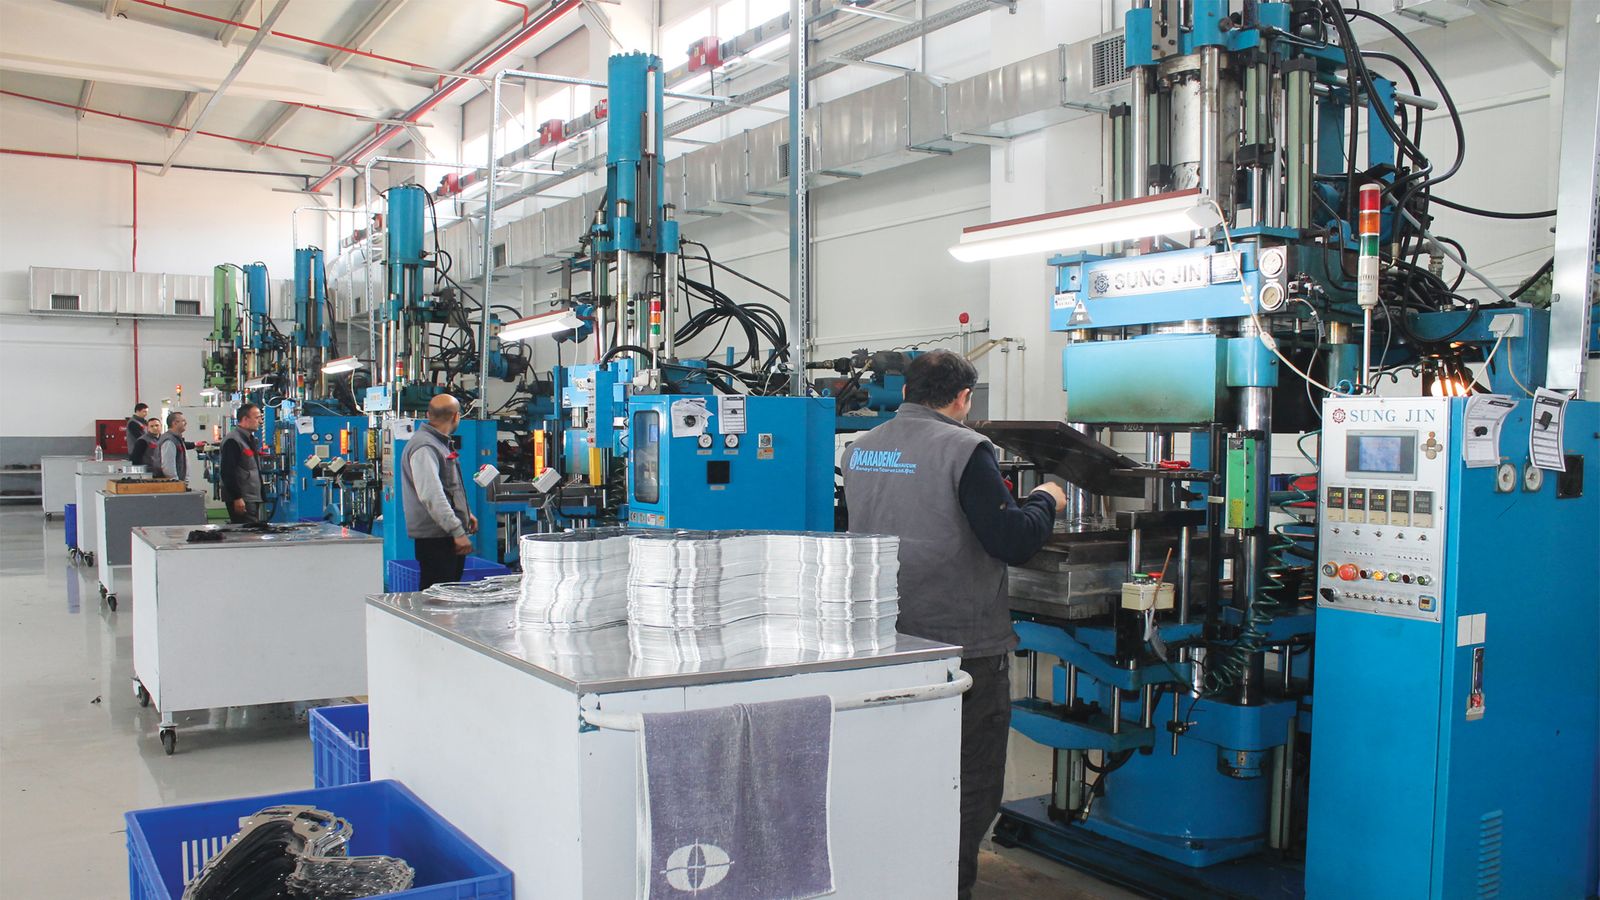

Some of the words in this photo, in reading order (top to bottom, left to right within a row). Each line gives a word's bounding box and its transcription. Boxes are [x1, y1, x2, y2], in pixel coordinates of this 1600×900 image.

[1114, 268, 1166, 290] SUNG
[1172, 264, 1201, 284] JIN
[1350, 409, 1397, 423] SUNG
[1405, 409, 1436, 423] JIN
